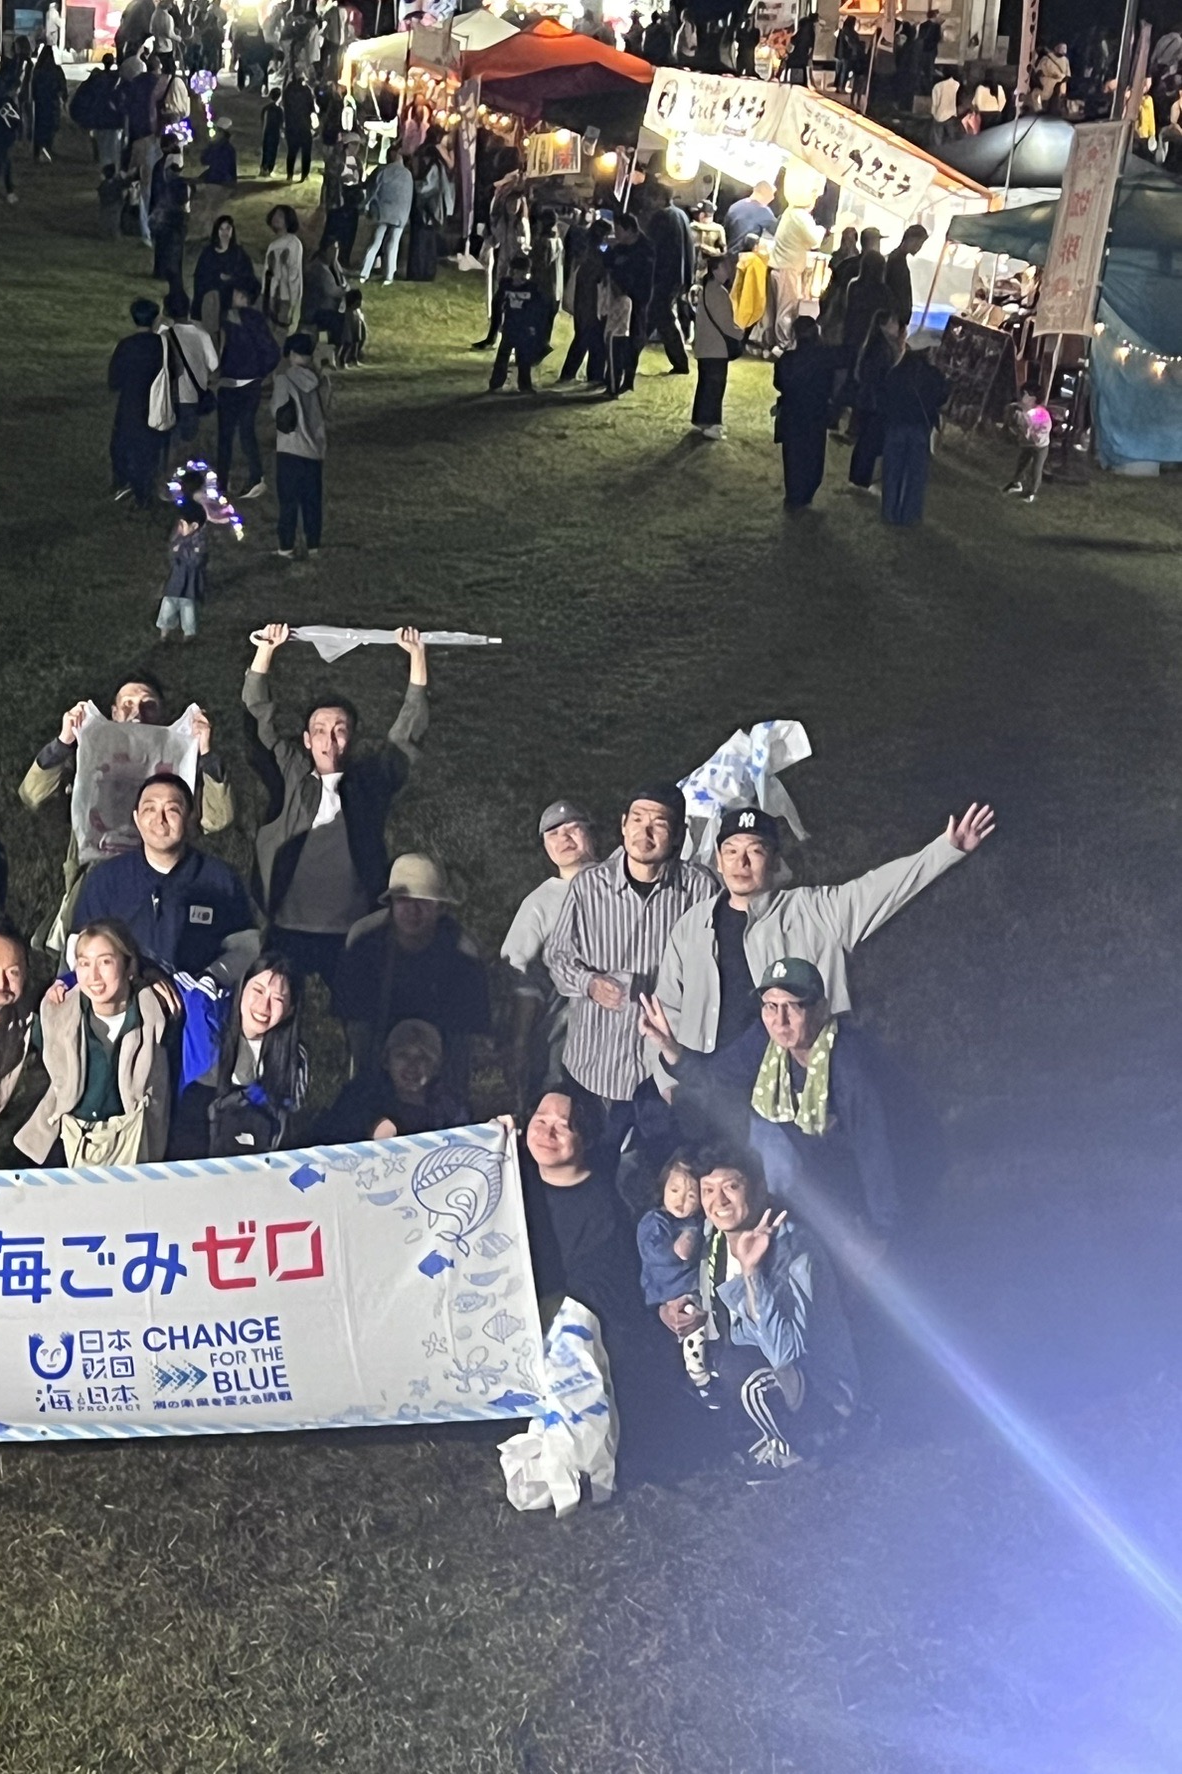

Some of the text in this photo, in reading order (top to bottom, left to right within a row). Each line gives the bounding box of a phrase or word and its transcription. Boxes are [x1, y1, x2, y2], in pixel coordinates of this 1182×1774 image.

[800, 122, 911, 198] ひとくちカステラ
[79, 1329, 132, 1353] 日本
[143, 1316, 281, 1352] CHANGE
[210, 1346, 284, 1368] FOR THE
[213, 1365, 289, 1394] BLUE
